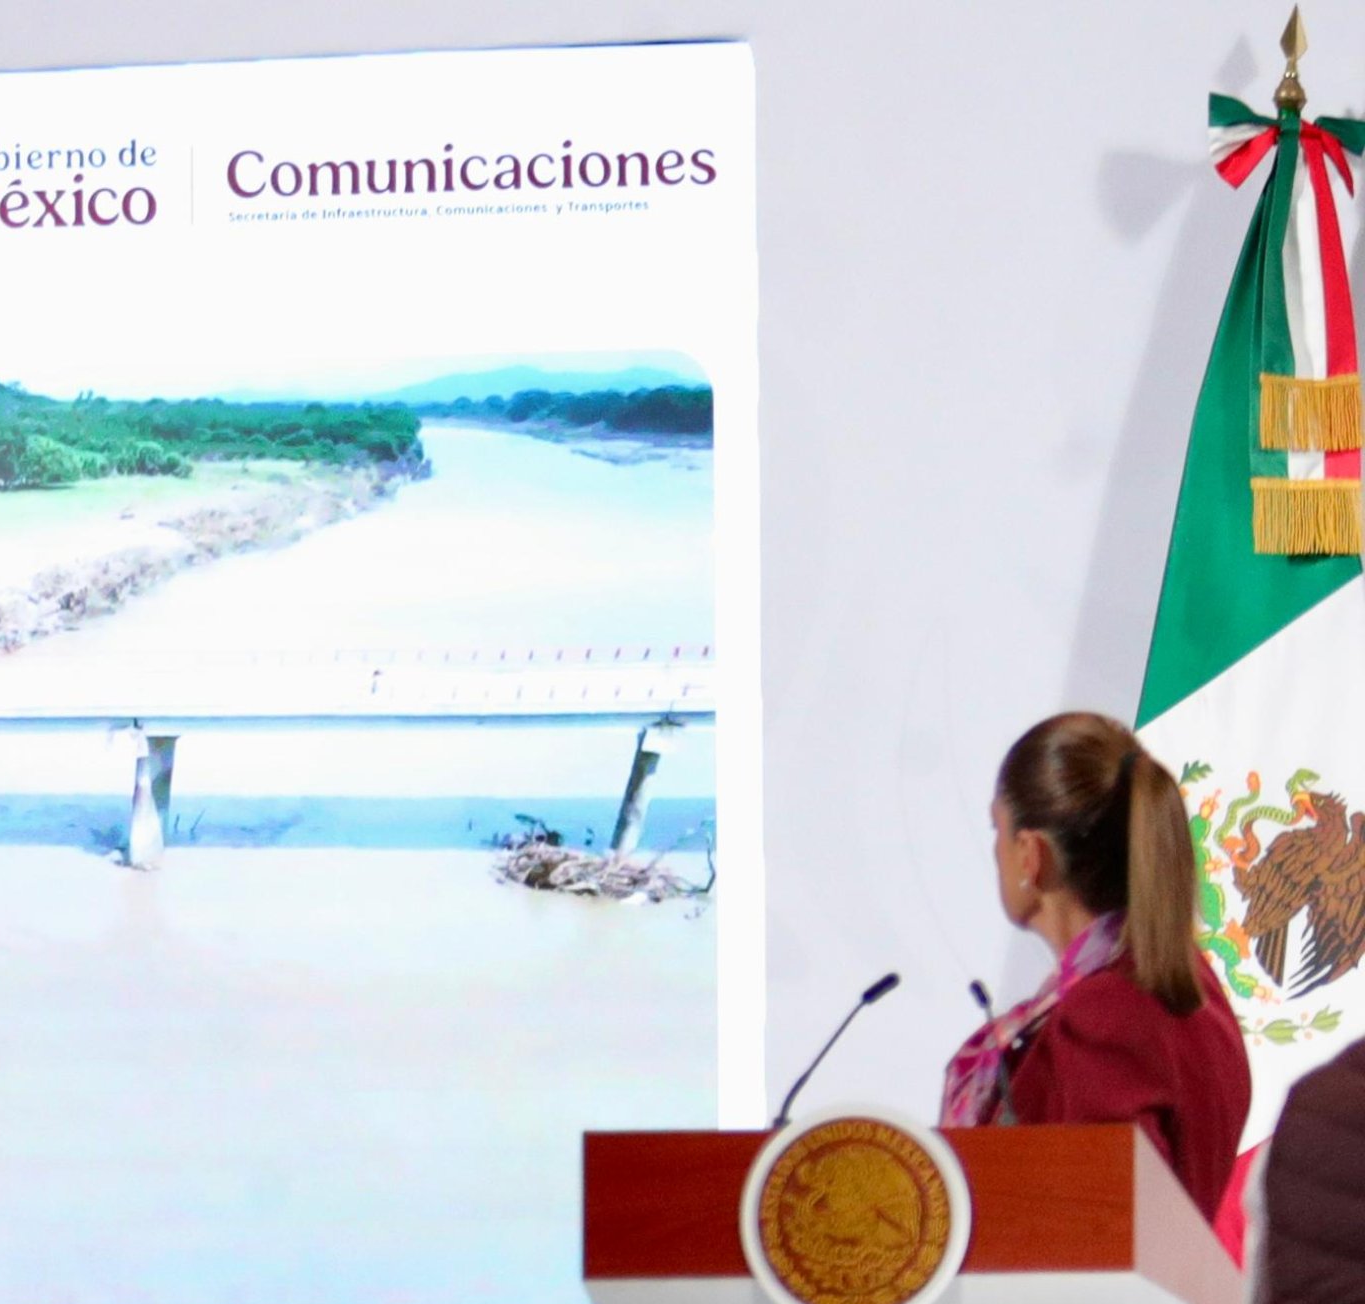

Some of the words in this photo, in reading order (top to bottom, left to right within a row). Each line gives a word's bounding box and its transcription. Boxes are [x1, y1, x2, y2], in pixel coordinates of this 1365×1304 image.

[118, 139, 157, 168] de
[226, 139, 718, 200] Comunicaciones
[301, 209, 318, 219] de
[435, 203, 548, 216] Comunicaciones
[555, 203, 563, 214] y
[568, 199, 650, 213] Transportes
